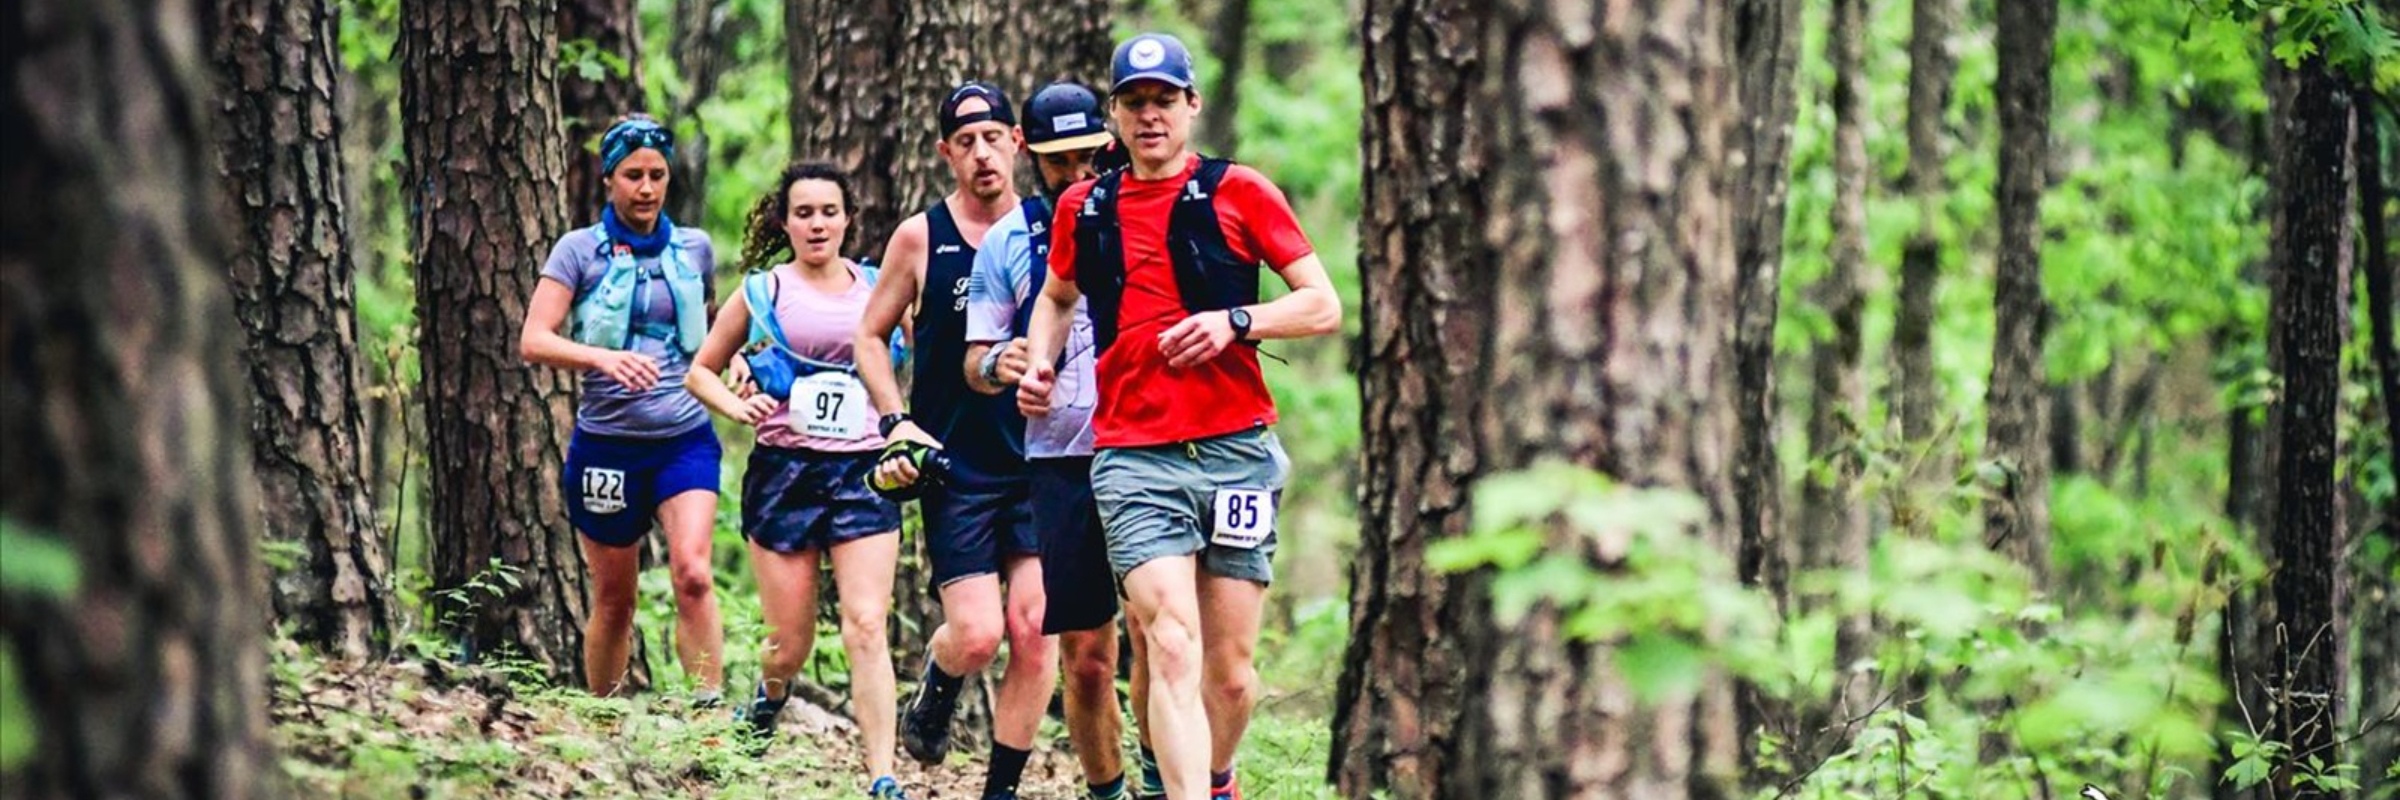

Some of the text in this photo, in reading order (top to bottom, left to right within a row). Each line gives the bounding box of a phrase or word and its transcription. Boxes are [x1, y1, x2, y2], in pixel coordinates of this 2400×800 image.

[816, 392, 844, 422] 97
[583, 471, 621, 500] 122
[1227, 494, 1257, 529] 85
